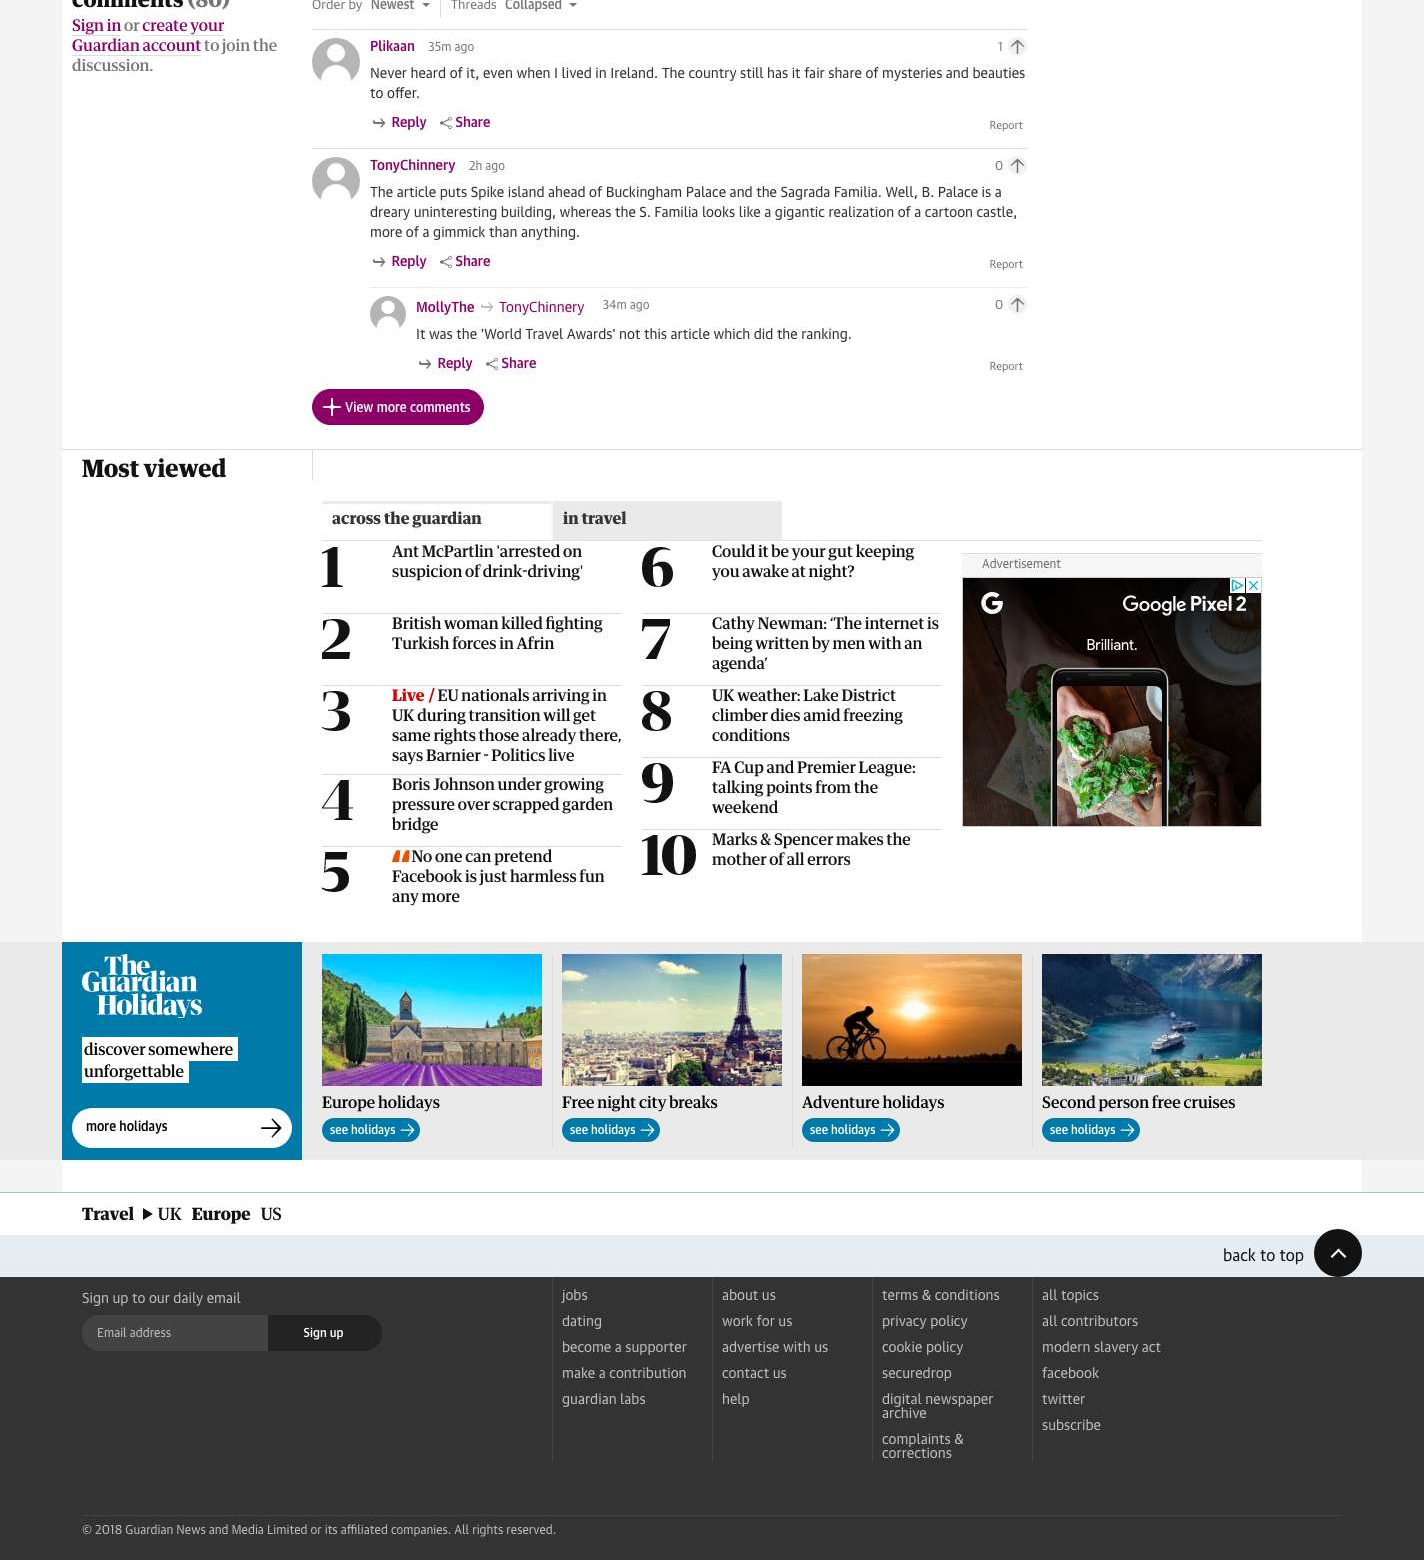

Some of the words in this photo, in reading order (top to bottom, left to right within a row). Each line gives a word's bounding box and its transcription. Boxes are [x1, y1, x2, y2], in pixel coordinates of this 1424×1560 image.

[370, 40, 414, 51] Plikaan
[429, 42, 451, 51] 35m
[454, 44, 474, 54] ago
[369, 159, 455, 173] TonyChinnery
[81, 459, 139, 478] Most
[142, 458, 226, 478] viewed
[332, 515, 381, 524] across
[383, 511, 409, 524] the
[411, 511, 482, 528] guardian
[1086, 639, 1137, 650] Brilliant.
[1223, 1248, 1256, 1261] back
[1259, 1250, 1275, 1261] to
[1279, 1250, 1304, 1265] top
[97, 1327, 126, 1337] Email
[129, 1327, 171, 1337] address
[881, 1341, 922, 1352] cookie
[926, 1341, 963, 1355] policy
[95, 1525, 122, 1534] 2018
[126, 1525, 173, 1534] Guardian
[177, 1525, 205, 1534] News
[209, 1525, 228, 1534] and
[231, 1524, 263, 1534] Media
[268, 1525, 307, 1534] Limited
[325, 1525, 337, 1534] its
[340, 1524, 387, 1534] affiliated
[390, 1525, 450, 1536] companies.
[454, 1524, 469, 1534] All
[472, 1525, 503, 1537] rights
[506, 1524, 555, 1534] reserved.
